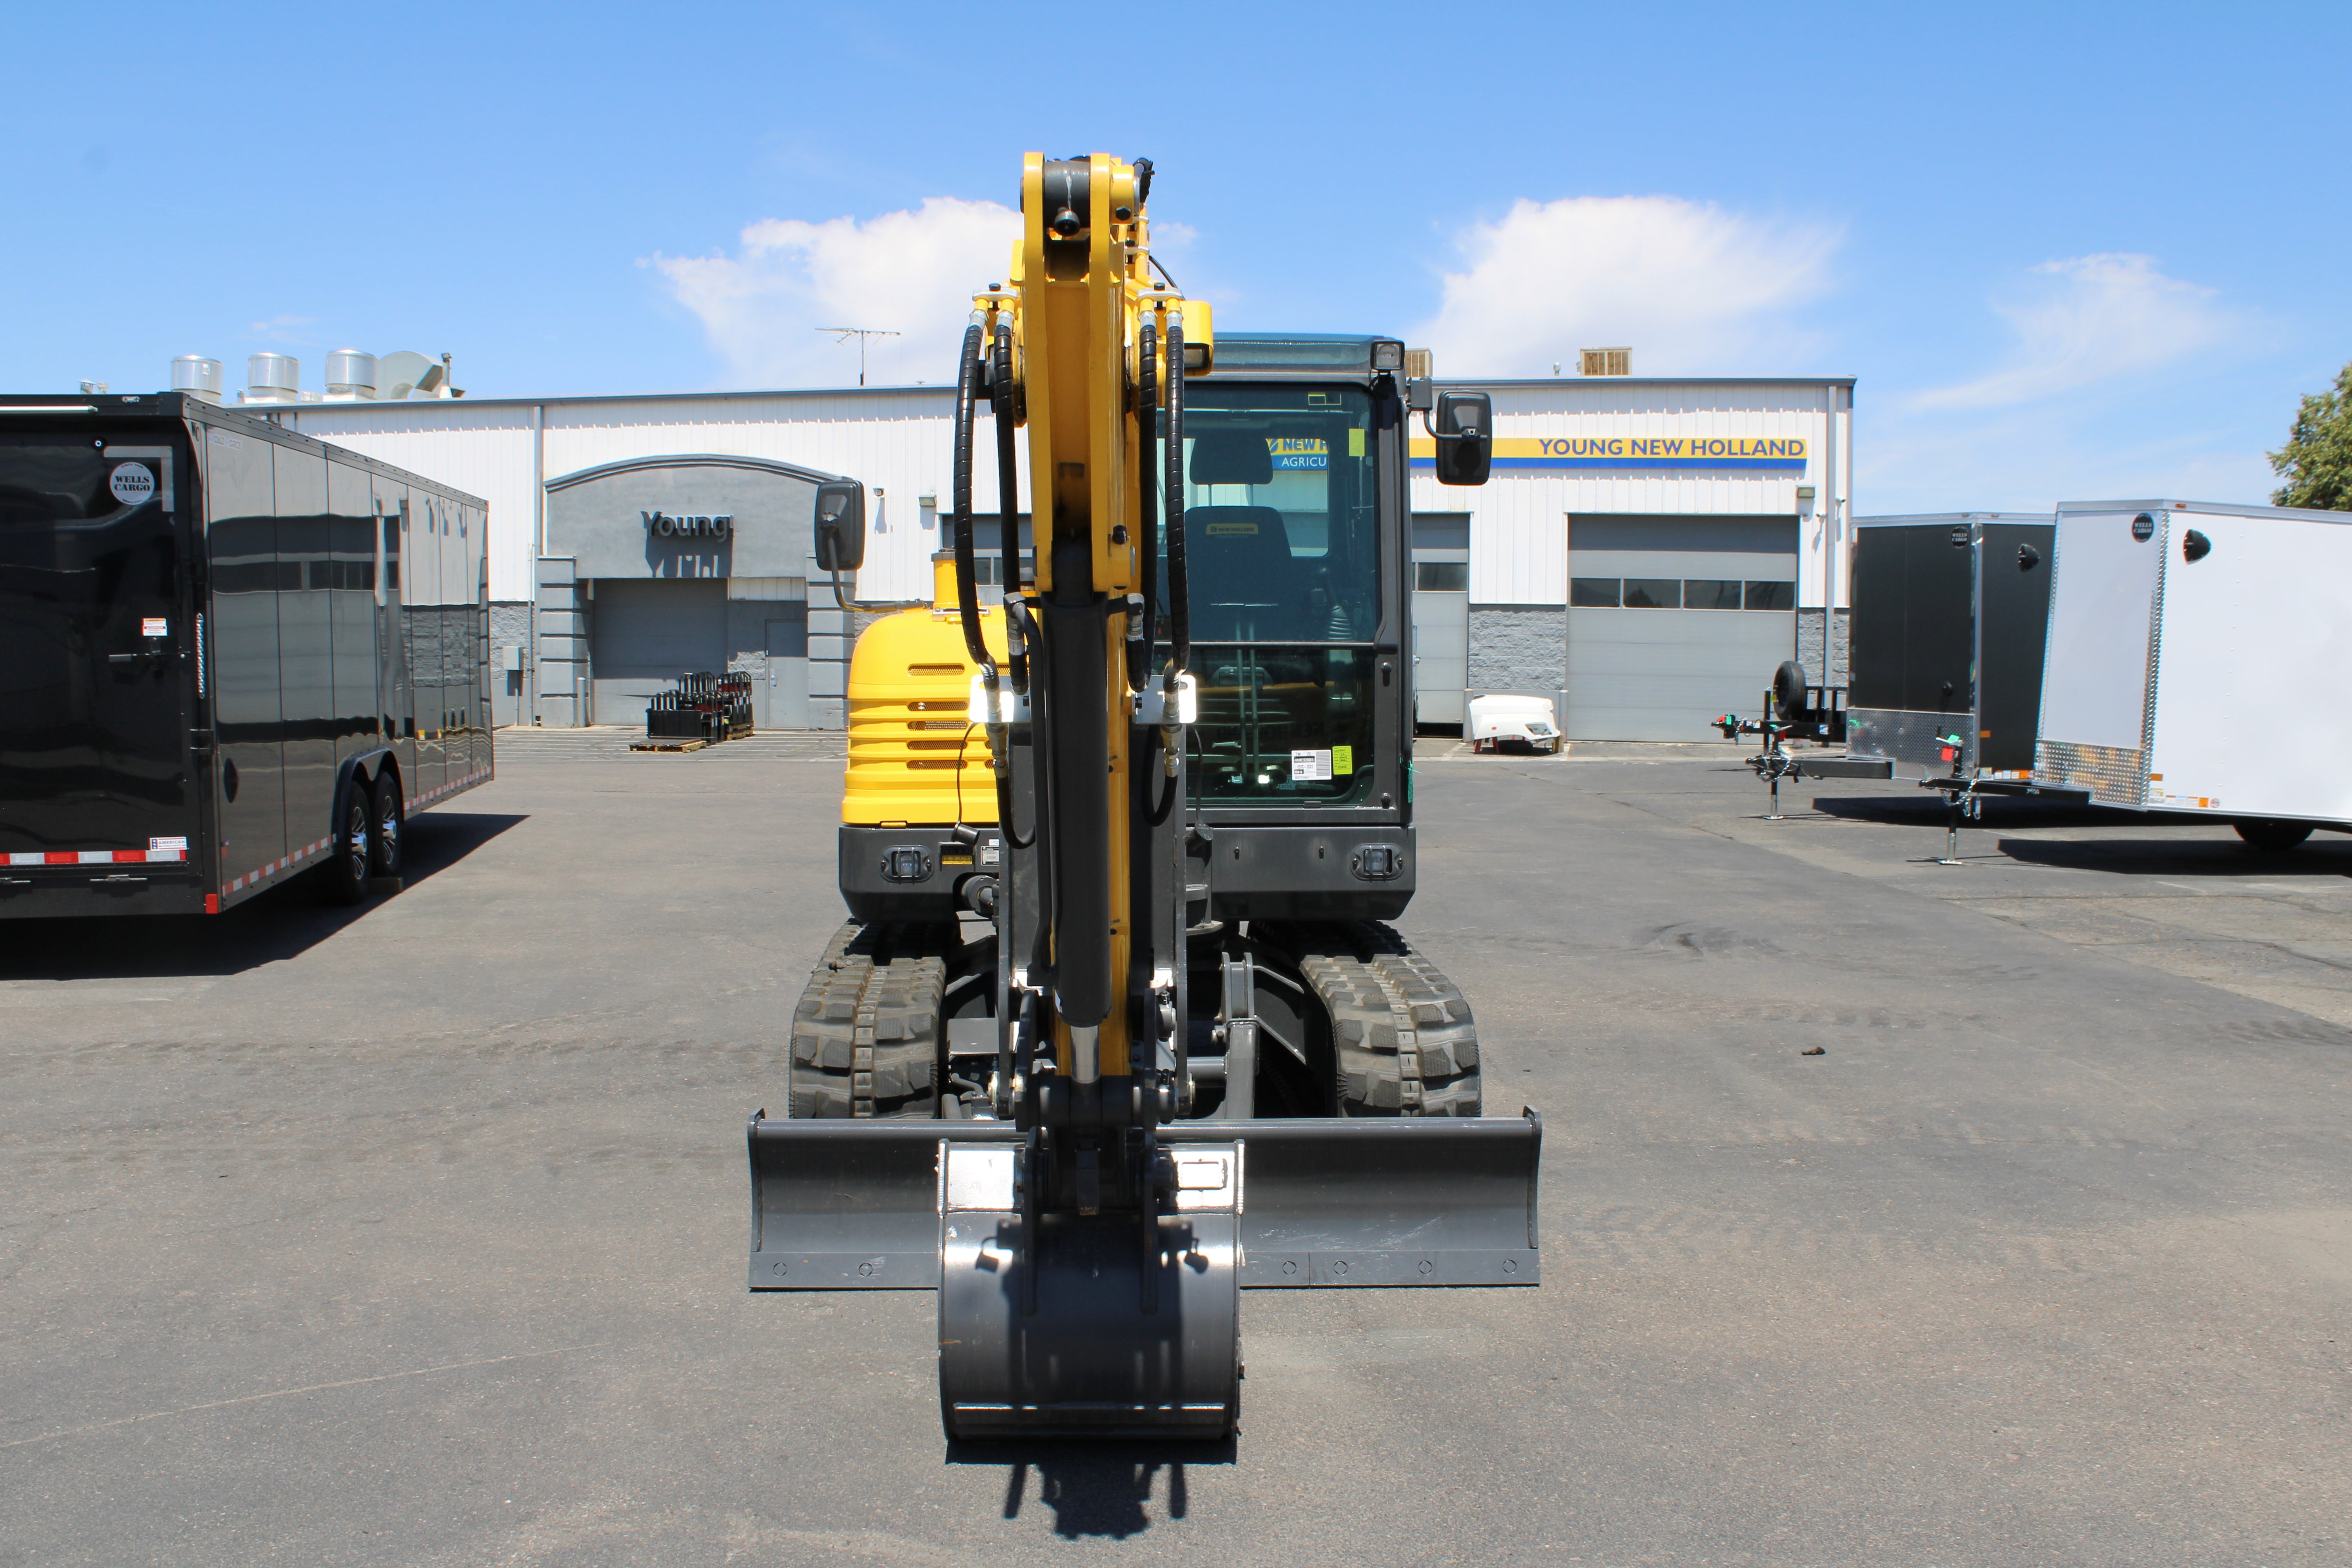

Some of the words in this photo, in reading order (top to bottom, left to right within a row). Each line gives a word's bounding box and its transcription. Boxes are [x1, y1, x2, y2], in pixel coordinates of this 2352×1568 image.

[1283, 439, 1316, 451] NEW
[1538, 439, 1623, 456] YOUNG
[1632, 439, 1684, 456] NEW
[1690, 439, 1804, 457] HOLLAND
[1281, 457, 1327, 467] AGRICU
[640, 511, 730, 543] Young
